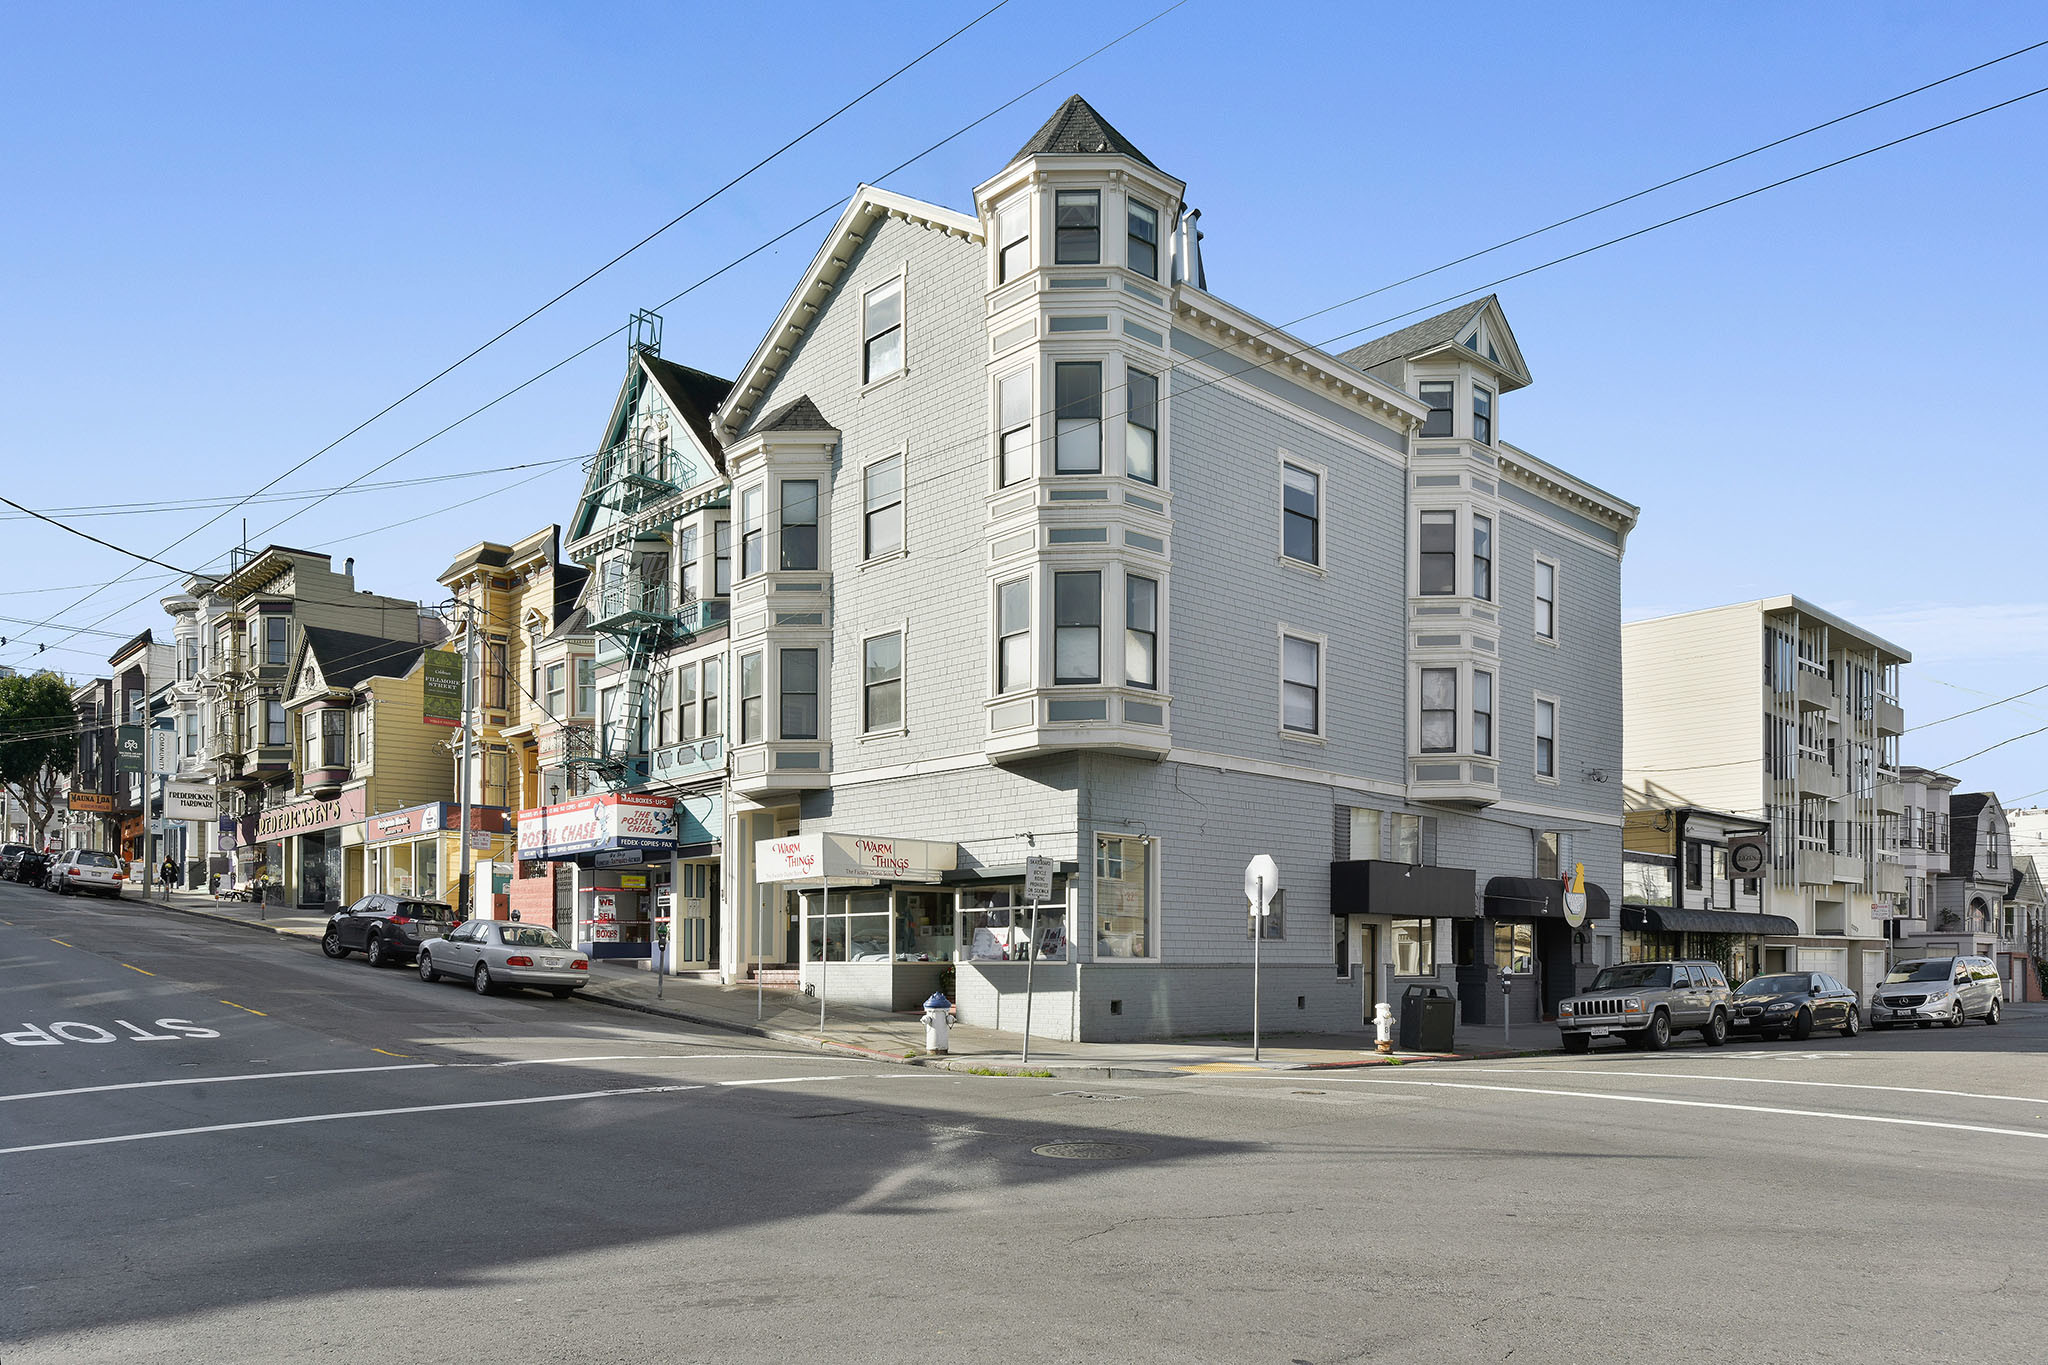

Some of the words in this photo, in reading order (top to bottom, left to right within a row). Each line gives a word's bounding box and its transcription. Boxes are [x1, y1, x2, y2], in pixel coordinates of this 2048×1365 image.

[425, 676, 461, 685] FILLMORE
[70, 794, 94, 802] MAUNA
[96, 796, 110, 804] LOA
[168, 792, 214, 800] FREDERICKSEN
[180, 800, 214, 808] HARDWARE
[621, 817, 652, 826] POSTAL
[627, 825, 657, 833] CHASE
[520, 828, 557, 848] POSTAL
[562, 822, 597, 842] CHASE
[772, 842, 800, 854] WARM
[856, 840, 892, 854] WARM
[785, 854, 814, 874] THINGS
[872, 855, 909, 876] THINGS
[599, 913, 615, 921] SELL
[596, 929, 618, 938] BOXES
[0, 1018, 221, 1046] STOP
